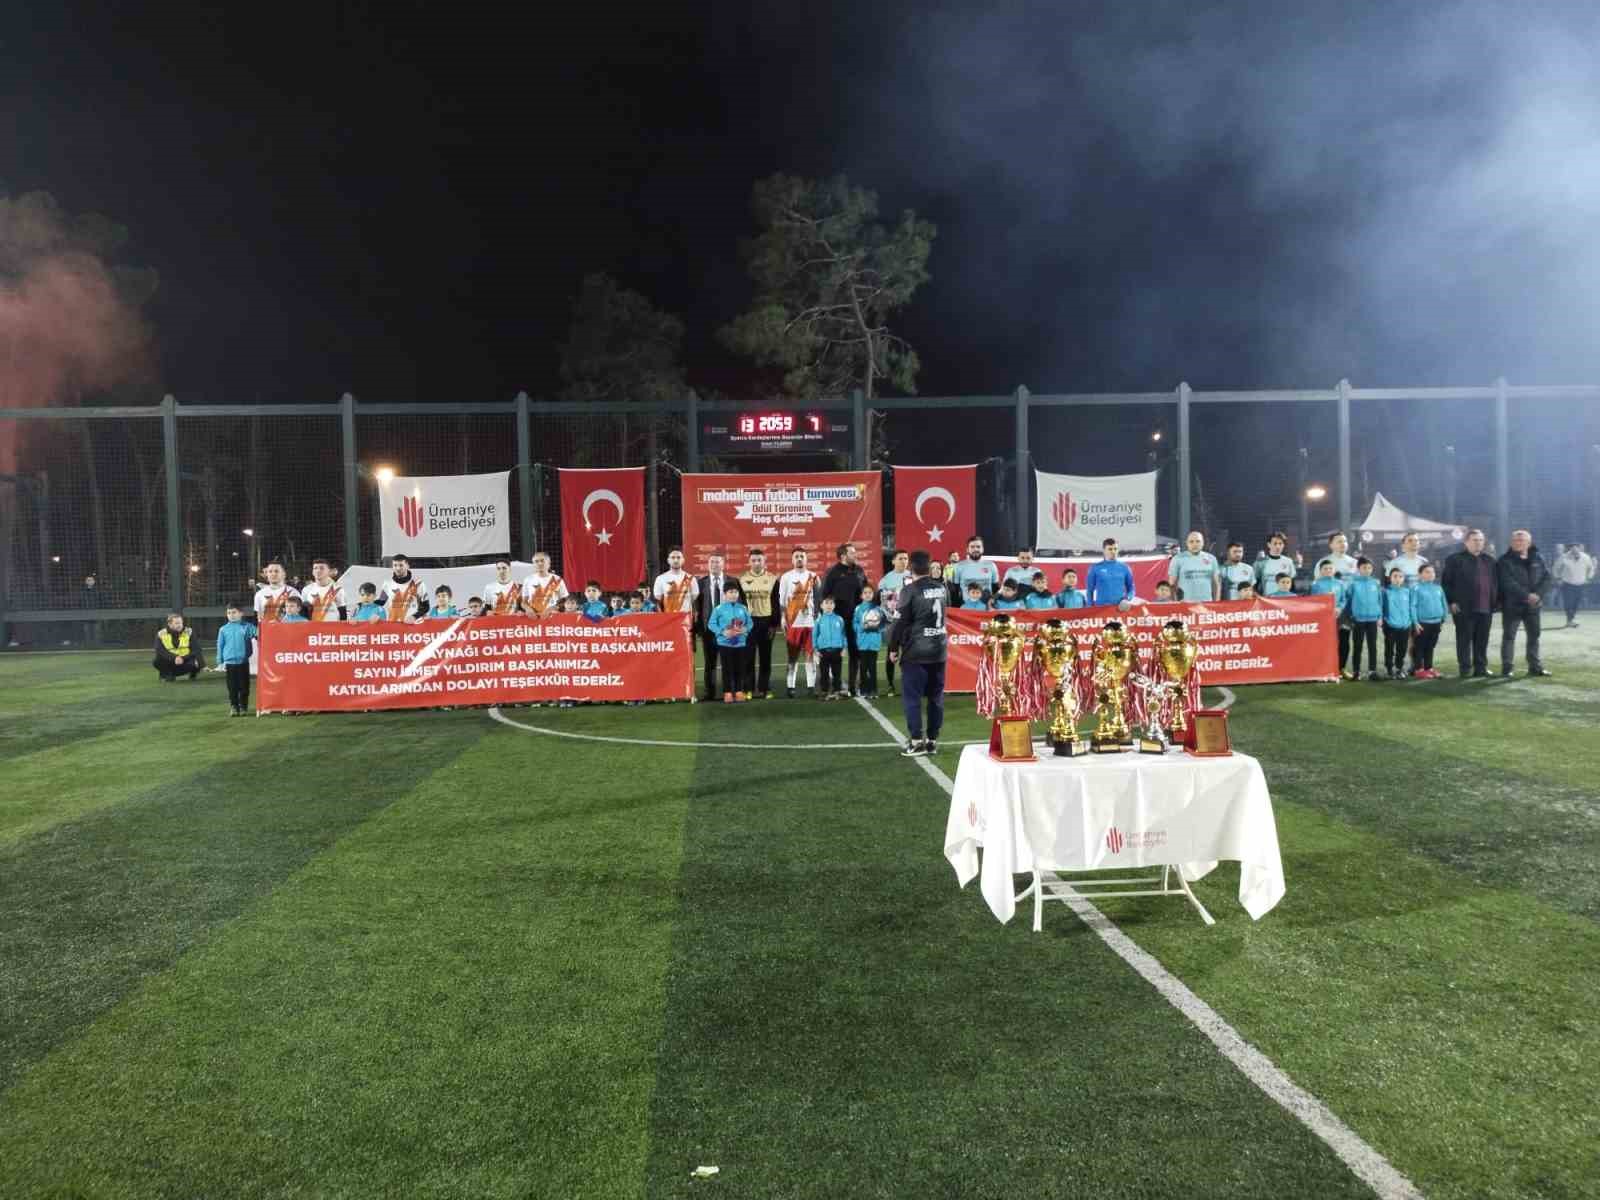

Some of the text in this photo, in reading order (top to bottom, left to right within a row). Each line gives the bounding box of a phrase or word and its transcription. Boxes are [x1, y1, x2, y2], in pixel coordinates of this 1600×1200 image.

[806, 487, 857, 500] turnuvası
[429, 502, 496, 517] Ümraniye
[1080, 500, 1143, 514] Ümraniye
[430, 514, 496, 531] Belediyesi
[1080, 513, 1142, 528] Belediyesi
[932, 599, 942, 628] 1
[1199, 610, 1289, 625] ESİRGEMEYEN,
[308, 631, 367, 646] BİZLERE
[370, 632, 400, 645] HER
[470, 625, 543, 641] DESTEĞİNİ
[545, 624, 641, 639] ESİRGEMEYEN,
[1242, 623, 1319, 639] BAŞKANIMIZ
[275, 649, 384, 665] GENÇLERİMİZİN
[482, 644, 522, 657] OLAN
[525, 641, 588, 654] BELEDİYE
[592, 640, 675, 655] BAŞKANIMIZ
[354, 667, 397, 680] SAYIN
[443, 661, 505, 676] YILDIRIM
[508, 658, 600, 672] BAŞKANIMIZA
[1225, 656, 1273, 669] EDERİZ.
[329, 672, 625, 697] KATKILARINDAN DOLAYI TEŞEKKÜR EDERİZ.
